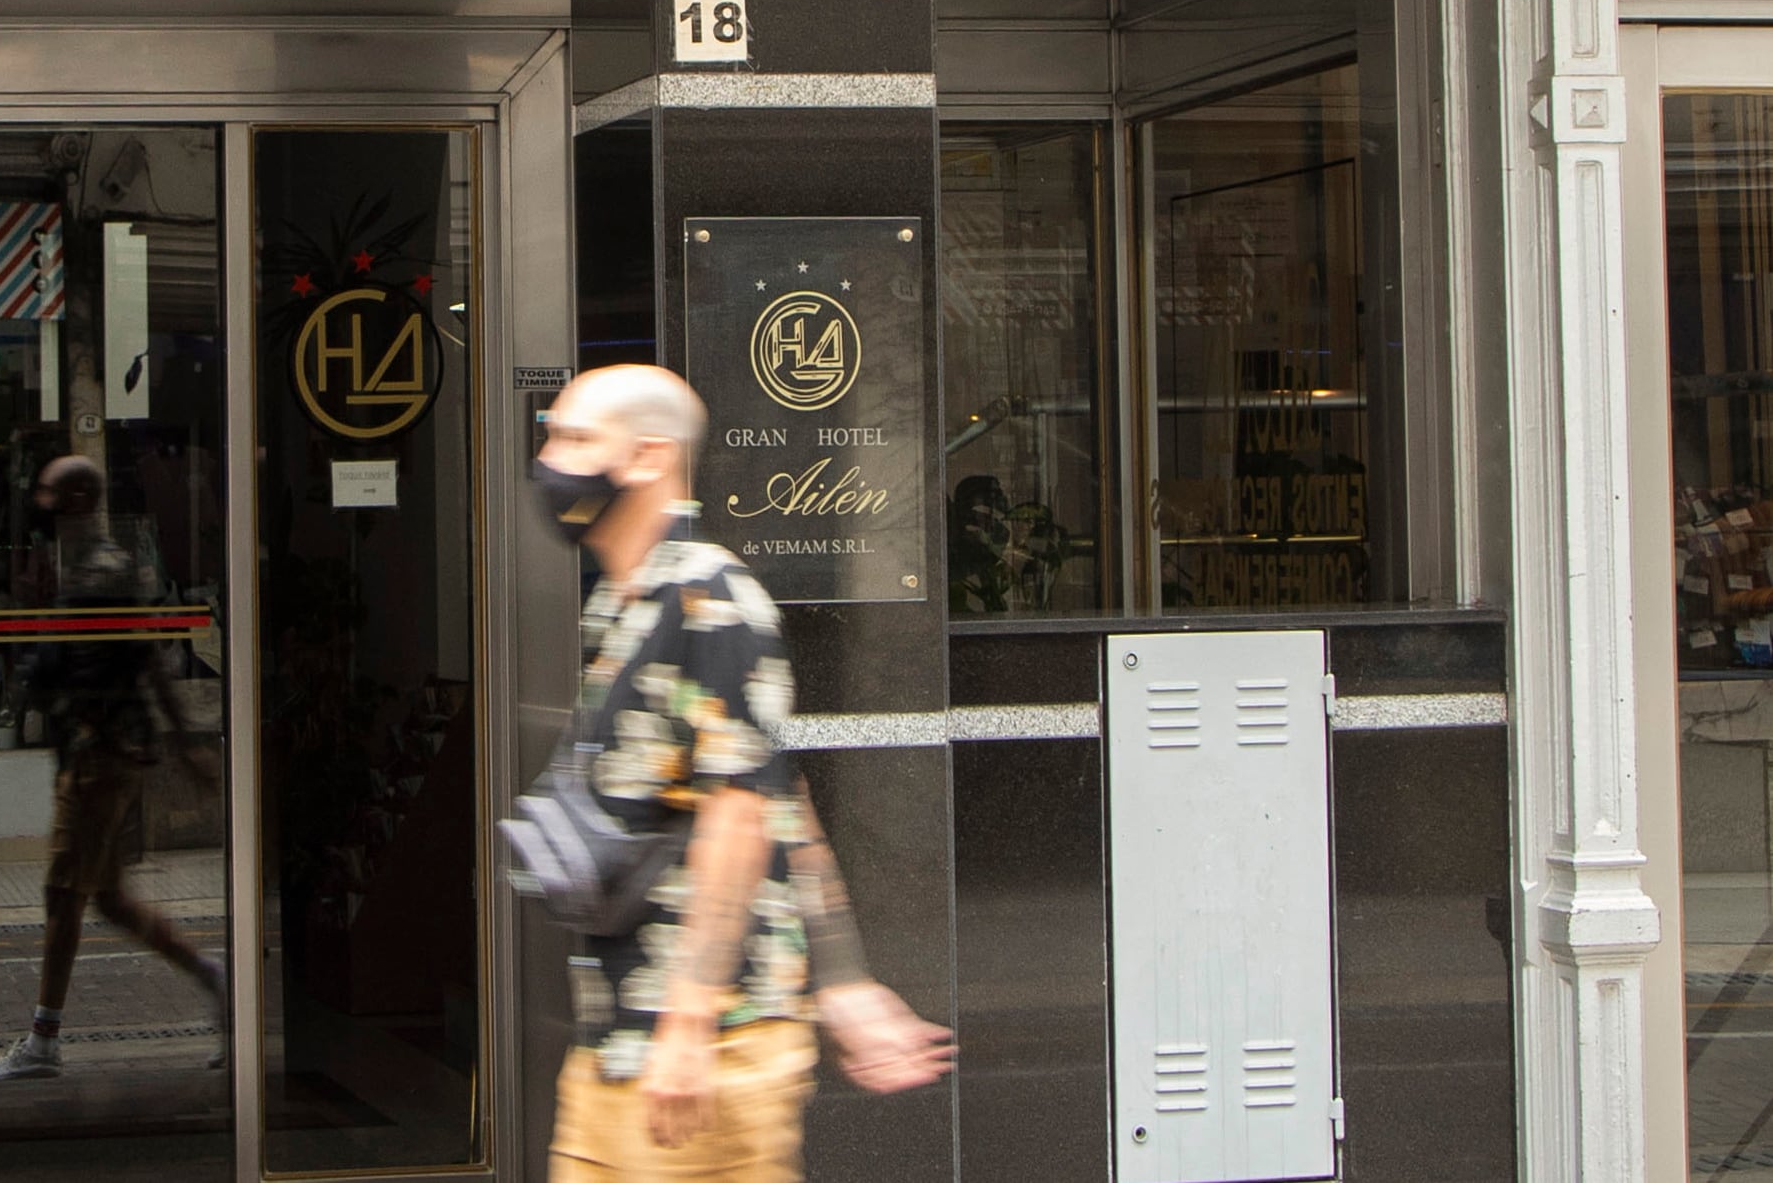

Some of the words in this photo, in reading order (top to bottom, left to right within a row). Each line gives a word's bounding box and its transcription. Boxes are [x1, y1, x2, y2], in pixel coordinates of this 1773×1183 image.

[679, 1, 745, 45] 18
[516, 378, 567, 387] TIMBRE
[518, 369, 565, 378] TOQUE
[726, 428, 787, 447] GRAN
[818, 427, 889, 447] HOTEL
[727, 456, 890, 518] Ailén
[743, 540, 760, 555] de
[763, 540, 828, 555] VEMAM
[831, 539, 876, 554] S.R.L.
